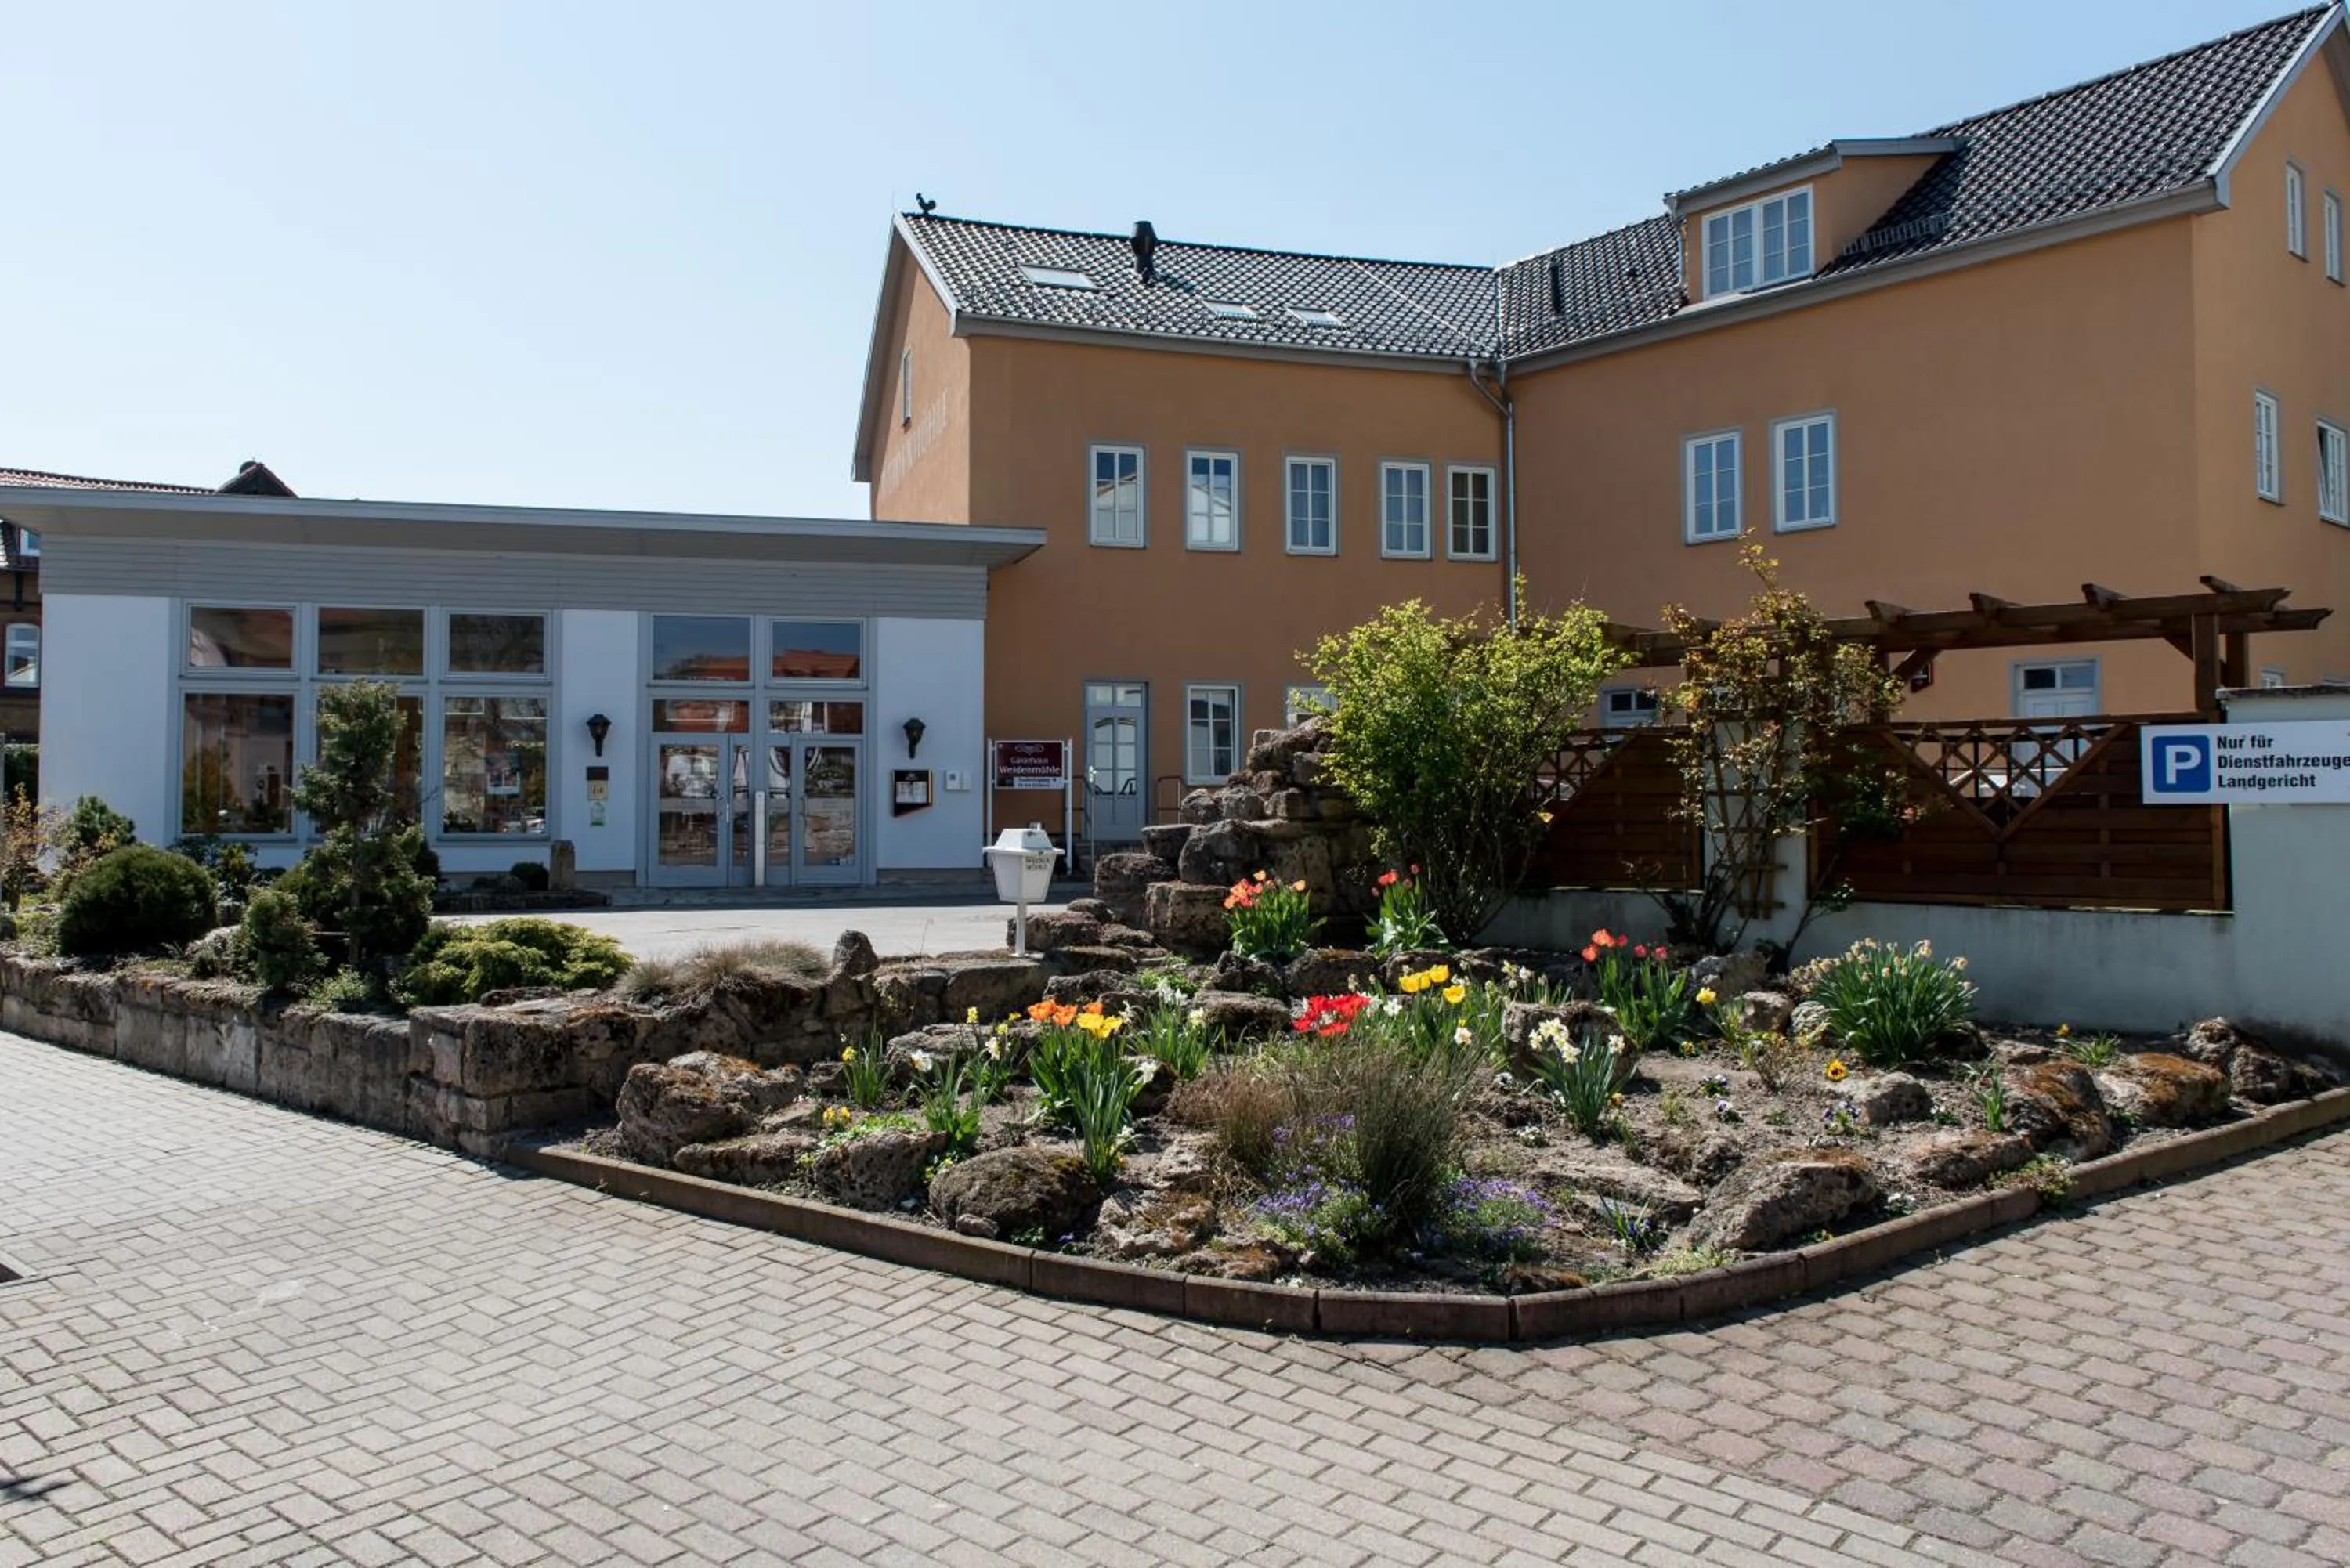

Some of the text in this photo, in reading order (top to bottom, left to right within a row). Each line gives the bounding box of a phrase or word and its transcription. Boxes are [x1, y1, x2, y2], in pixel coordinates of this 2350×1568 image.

[2218, 735, 2274, 749] Nur für
[2165, 745, 2202, 784] P
[2218, 754, 2350, 770] Dienstfahrzeuge
[2218, 774, 2316, 790] Landgericht
